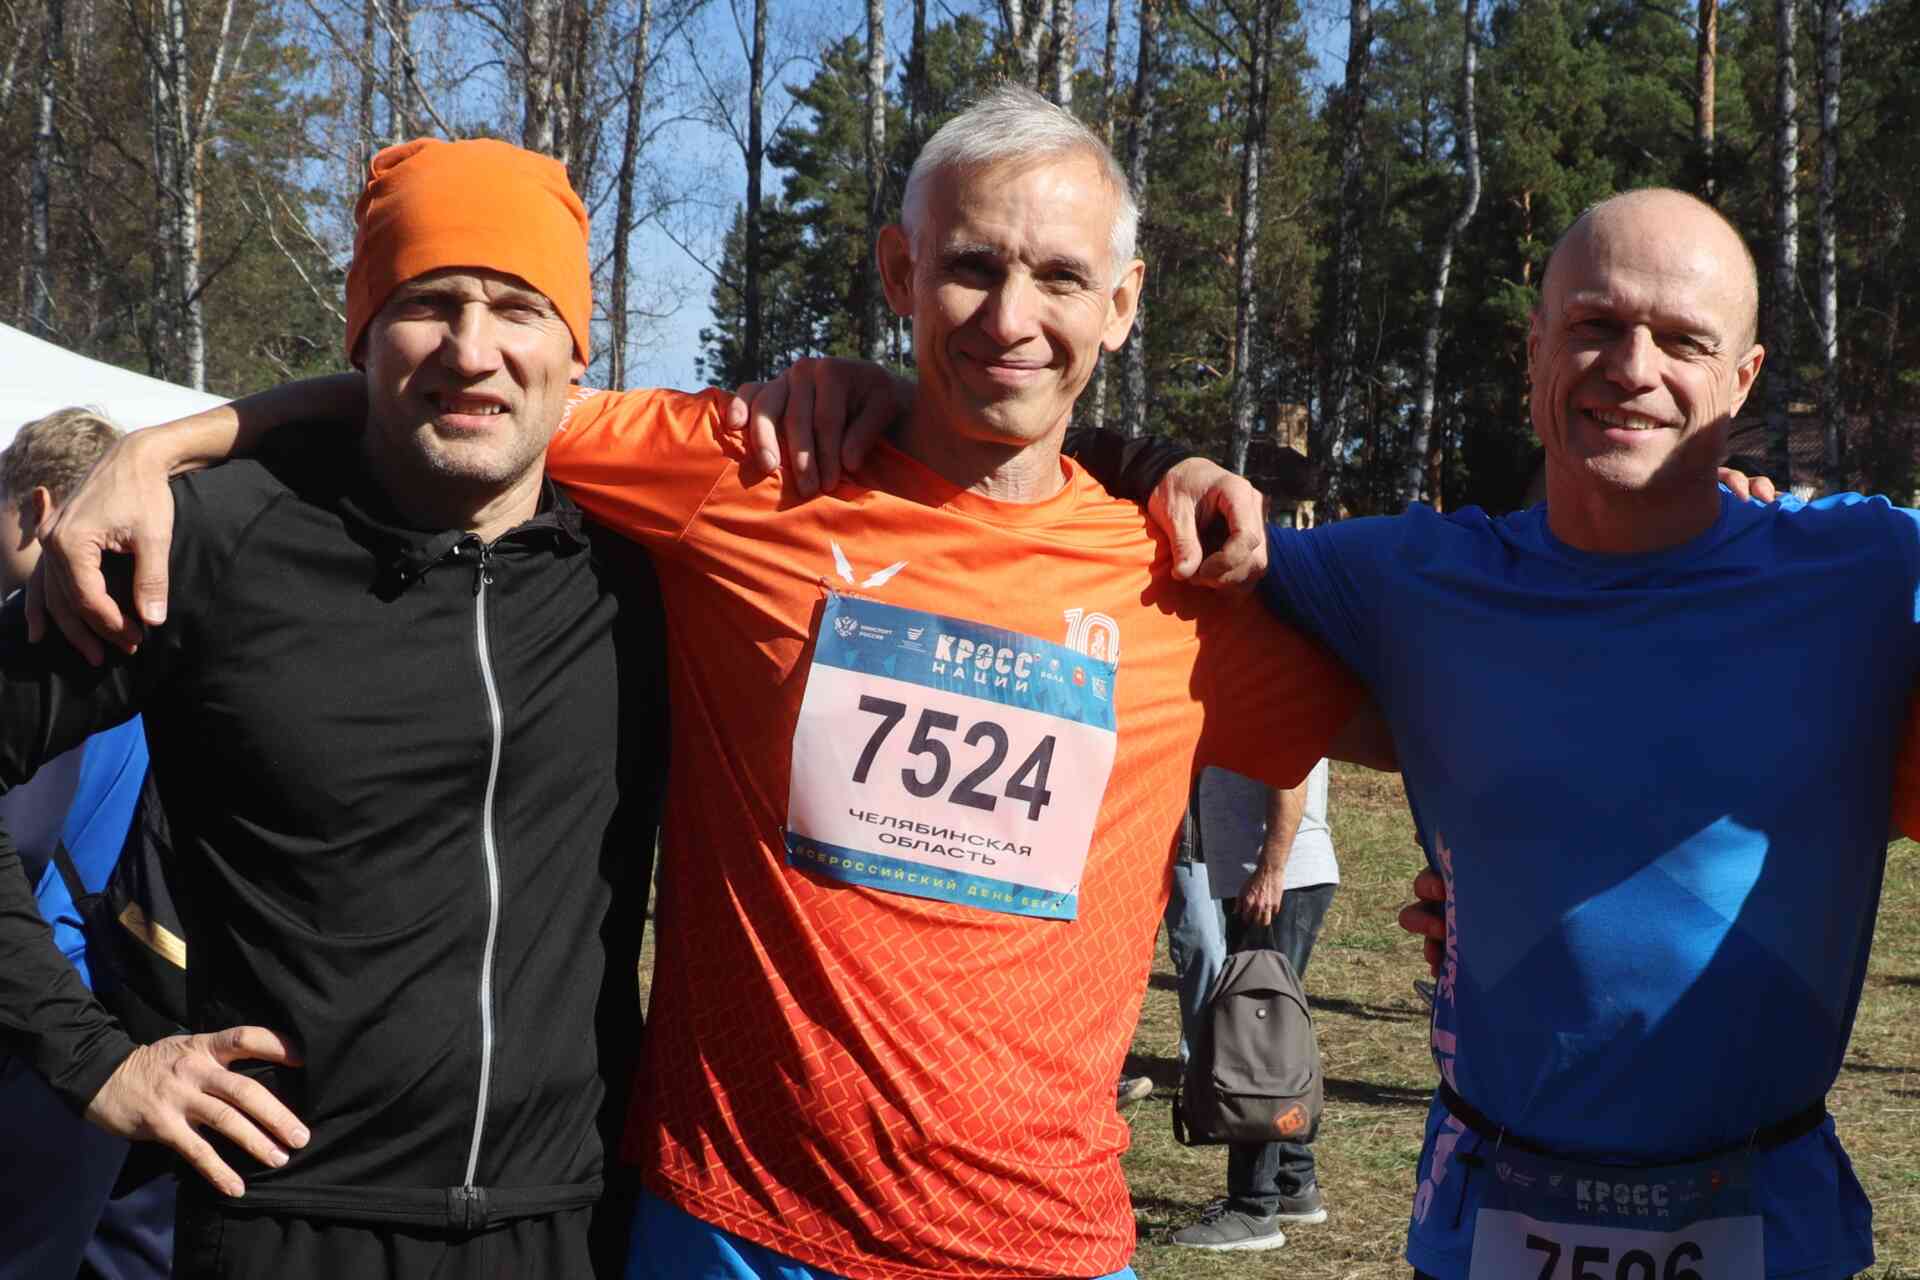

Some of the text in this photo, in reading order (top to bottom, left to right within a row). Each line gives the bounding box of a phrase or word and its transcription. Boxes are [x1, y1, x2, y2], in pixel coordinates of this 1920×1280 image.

[934, 633, 1034, 679] КРОСС
[932, 661, 1029, 694] НАЦИИ
[852, 694, 1056, 822] 7524
[849, 808, 1032, 857] ЧЕЛЯБИНСКАЯ
[878, 832, 996, 866] ОБЛАСТЬ
[1576, 1179, 1669, 1207] КРОСС
